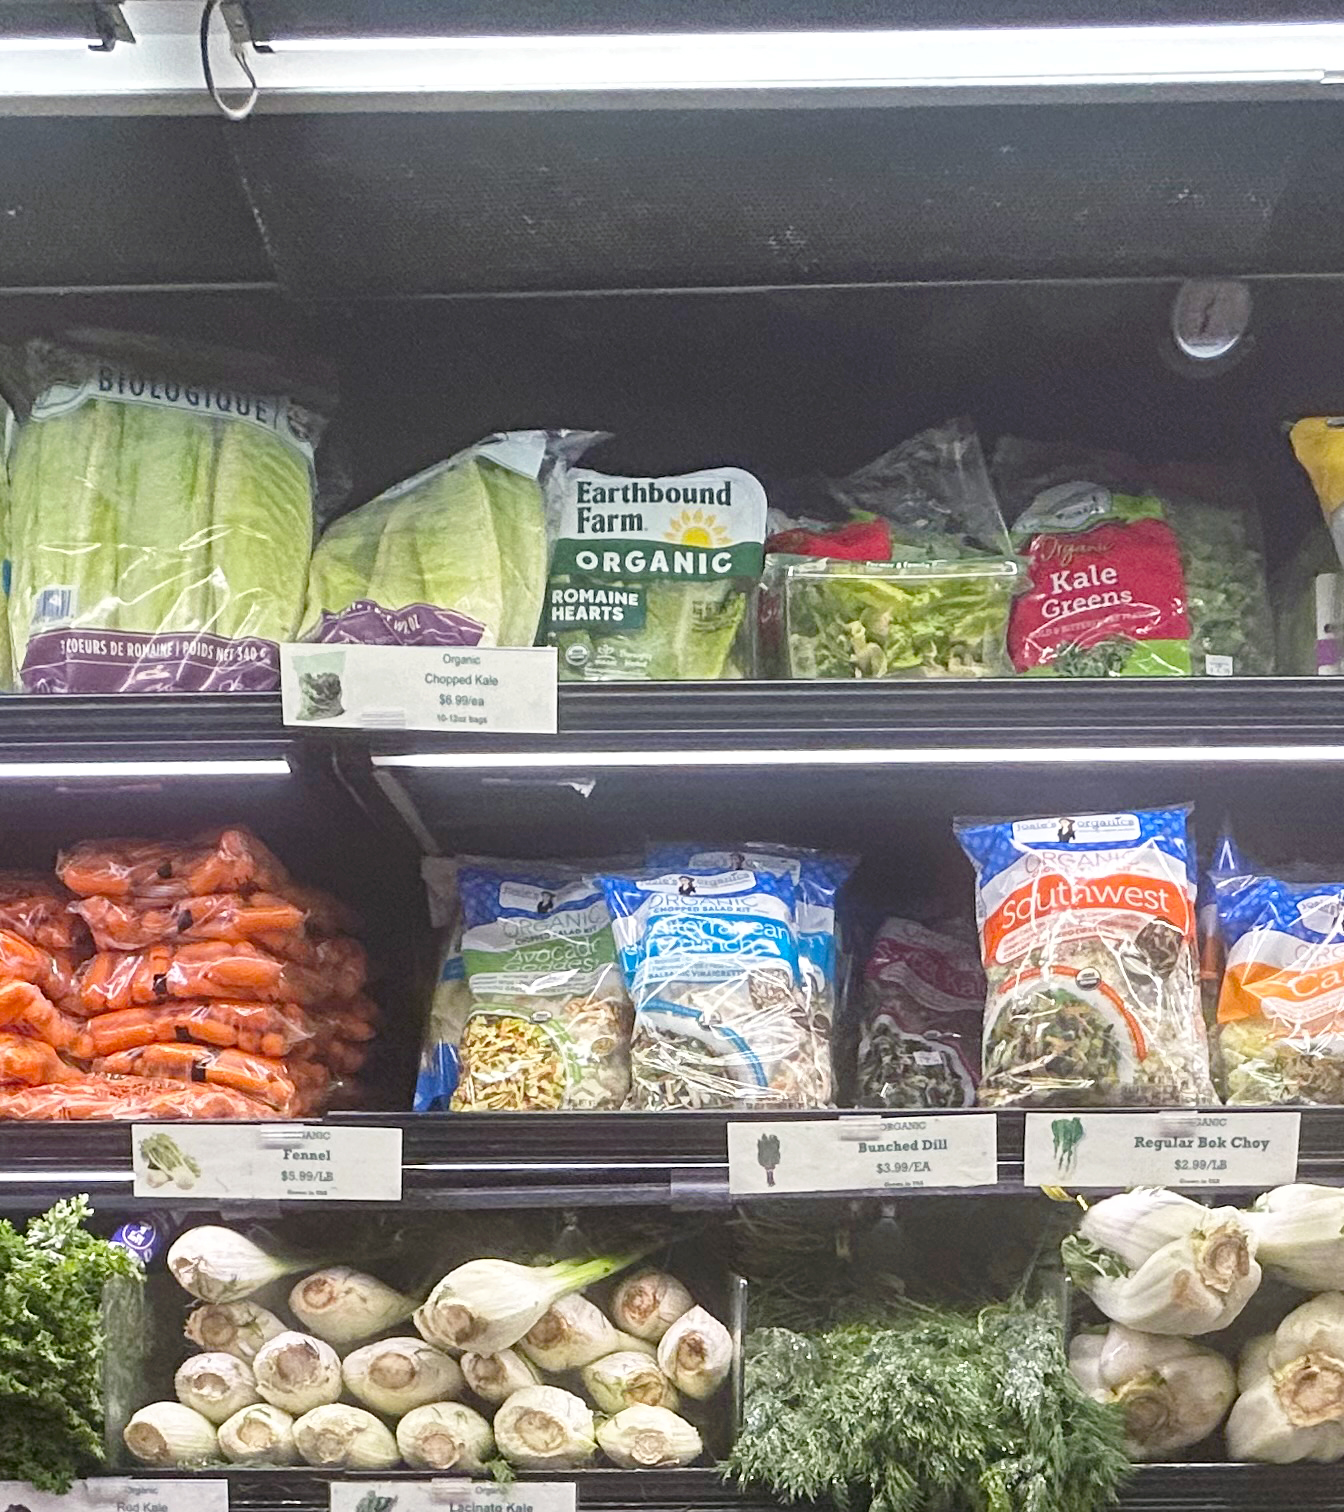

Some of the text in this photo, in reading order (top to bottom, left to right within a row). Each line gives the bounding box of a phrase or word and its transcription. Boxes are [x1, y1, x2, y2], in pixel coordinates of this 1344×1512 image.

[98, 366, 268, 425] BIOLOGIQUE
[576, 480, 732, 507] Earthbound
[576, 506, 644, 534] Farm
[575, 549, 733, 575] ORGANIC
[1049, 563, 1119, 596] Kale
[551, 587, 640, 606] ROMAINE
[1040, 588, 1134, 619] Greens
[551, 606, 625, 621] HEARTS
[66, 637, 107, 656] COEURS
[109, 641, 125, 657] DE
[181, 641, 214, 659] POIDS
[442, 653, 481, 666] Organic
[424, 672, 499, 687] Chopped Kale
[1076, 815, 1136, 832] organics
[1196, 1117, 1228, 1127] GANIC
[302, 1131, 331, 1140] ANIC
[857, 1138, 948, 1153] Bunched Dill
[1133, 1136, 1271, 1152] Regular Bok Choy
[282, 1149, 332, 1161] Fennel
[875, 1161, 932, 1174] $3.99/EA
[1174, 1159, 1228, 1171] $2.99/LB
[116, 1501, 169, 1512] Red Kale
